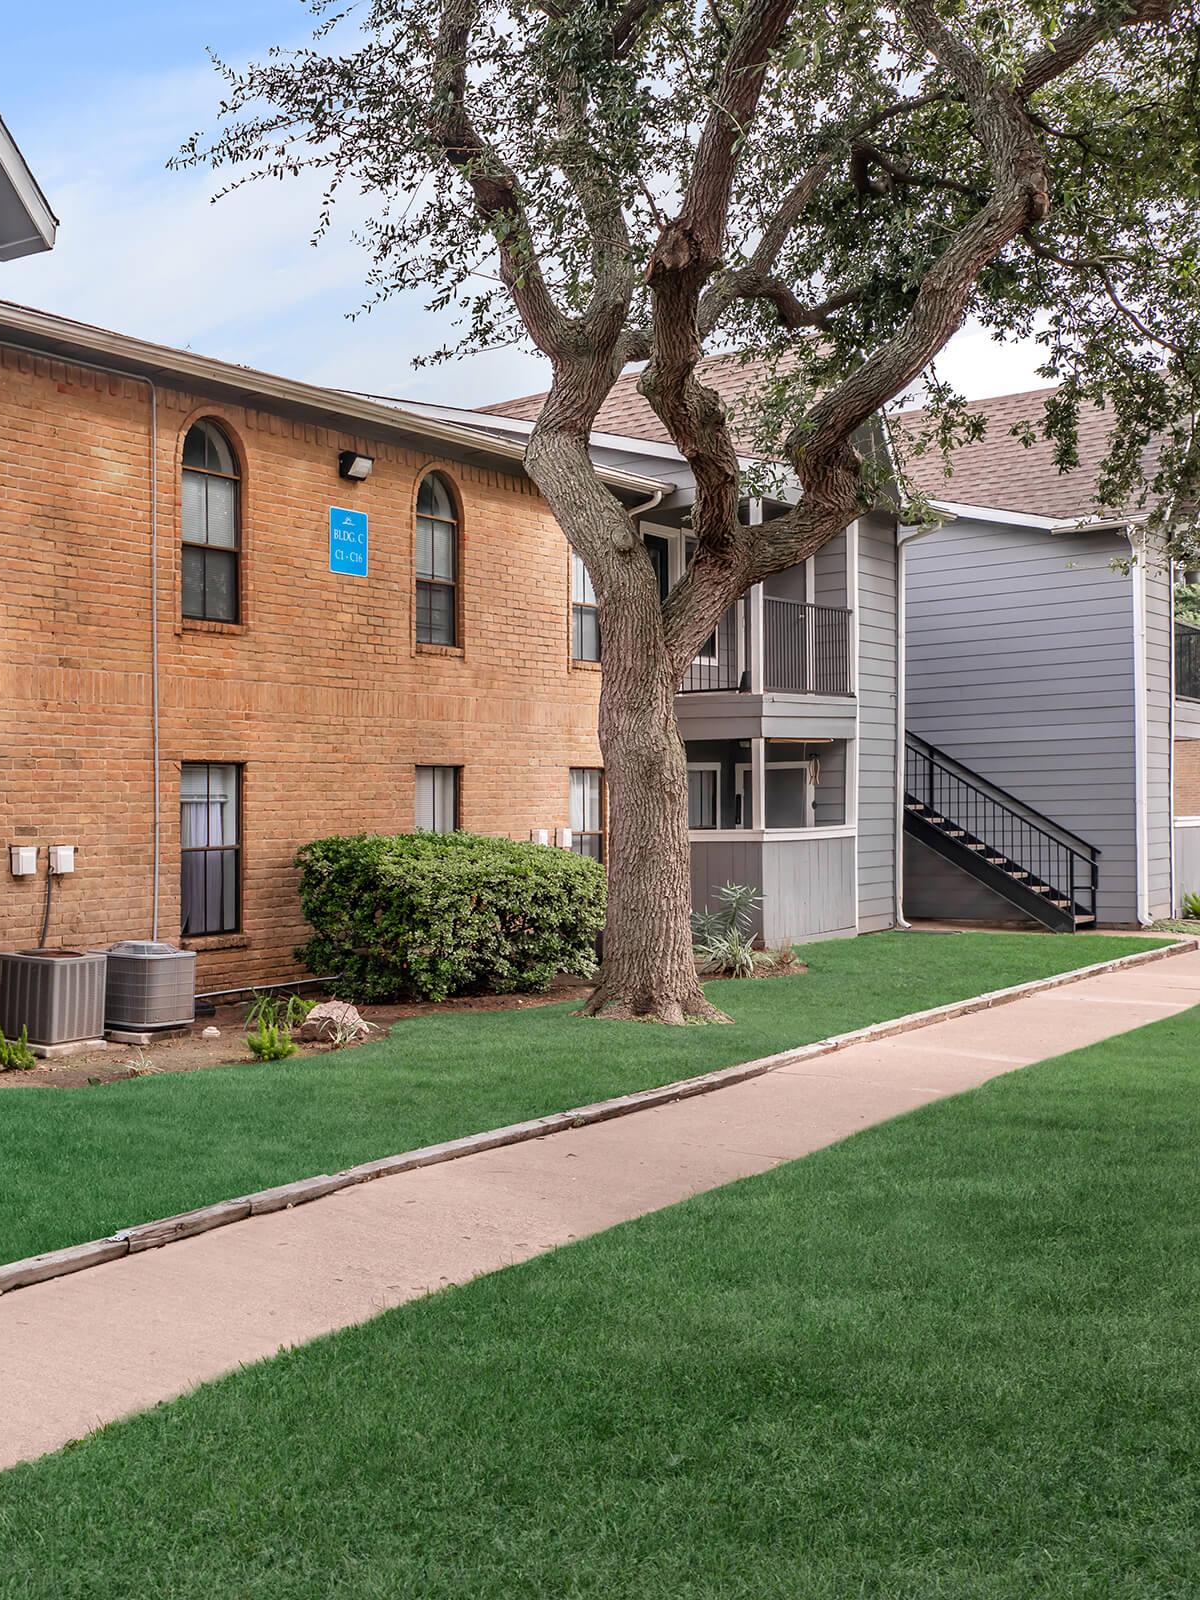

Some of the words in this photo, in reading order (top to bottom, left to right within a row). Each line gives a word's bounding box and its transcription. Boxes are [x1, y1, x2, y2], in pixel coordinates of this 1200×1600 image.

[334, 528, 357, 542] BLDG.
[358, 533, 364, 544] C
[335, 549, 344, 560] C1
[350, 552, 363, 563] C16
